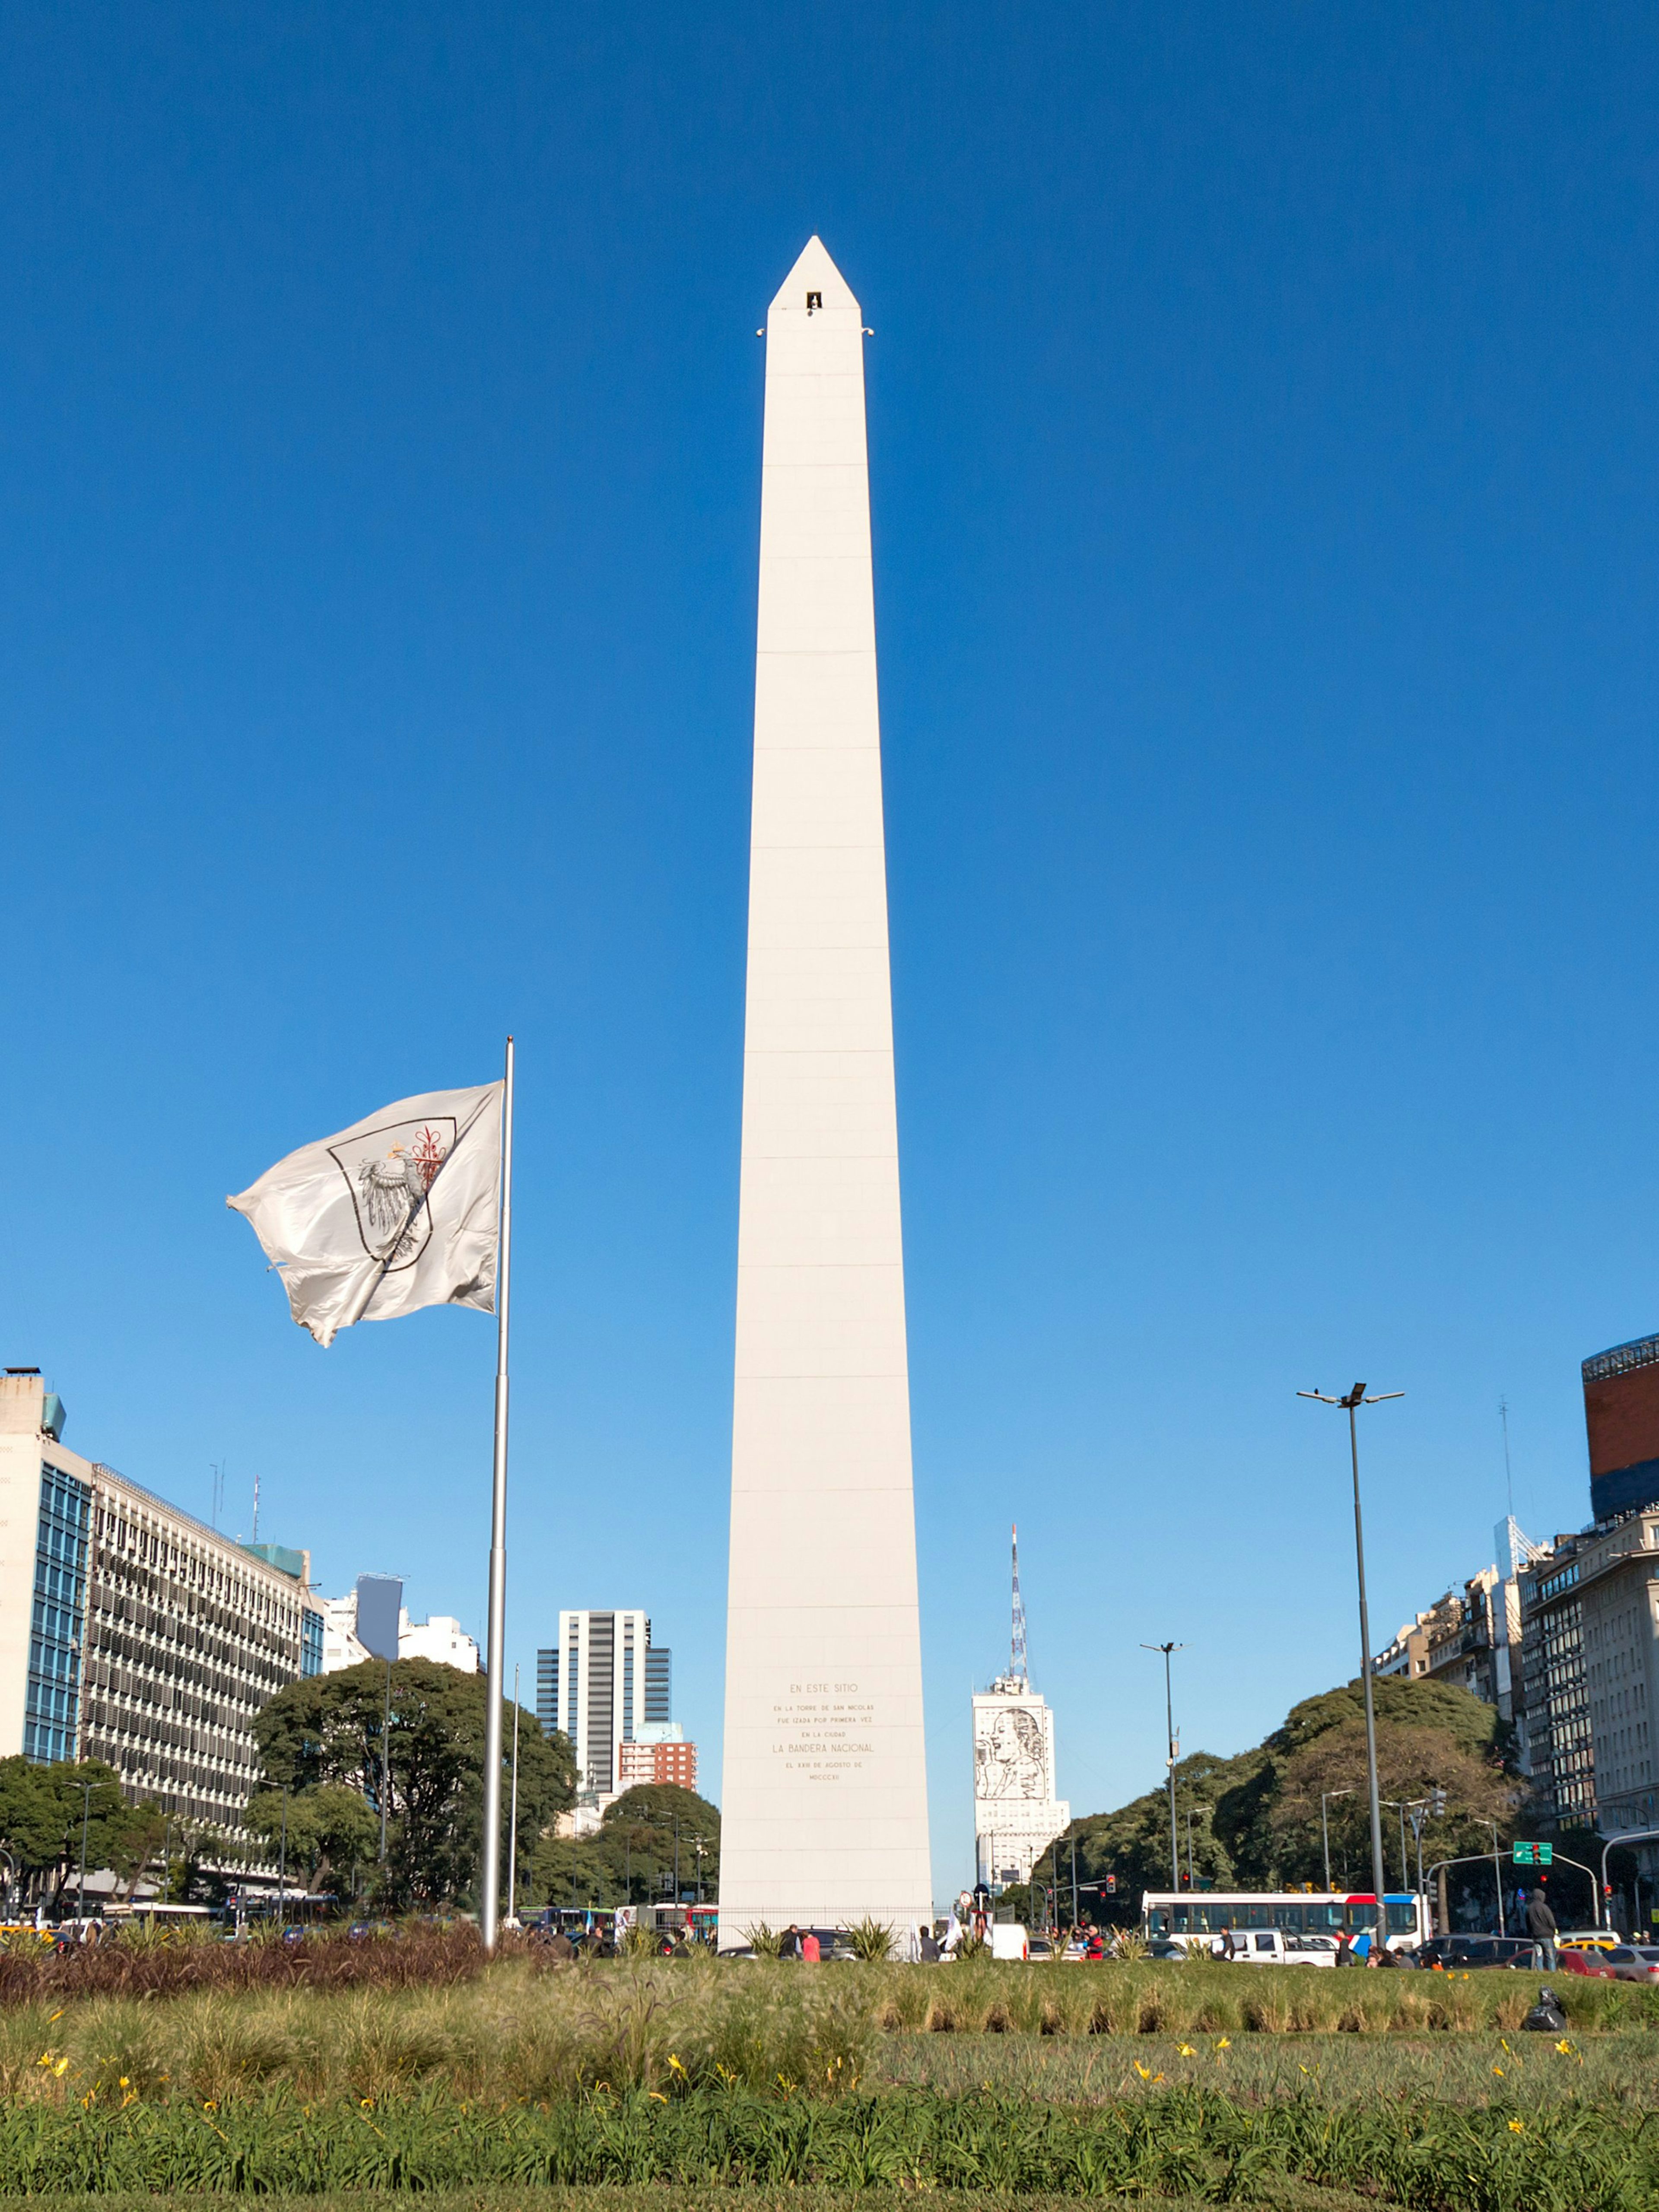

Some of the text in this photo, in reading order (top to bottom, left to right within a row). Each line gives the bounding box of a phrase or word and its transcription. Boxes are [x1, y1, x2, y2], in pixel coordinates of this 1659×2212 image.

[790, 1683, 858, 1693] EN ESTE SITIO
[772, 1744, 874, 1753] LA BANDERA NACIONAL
